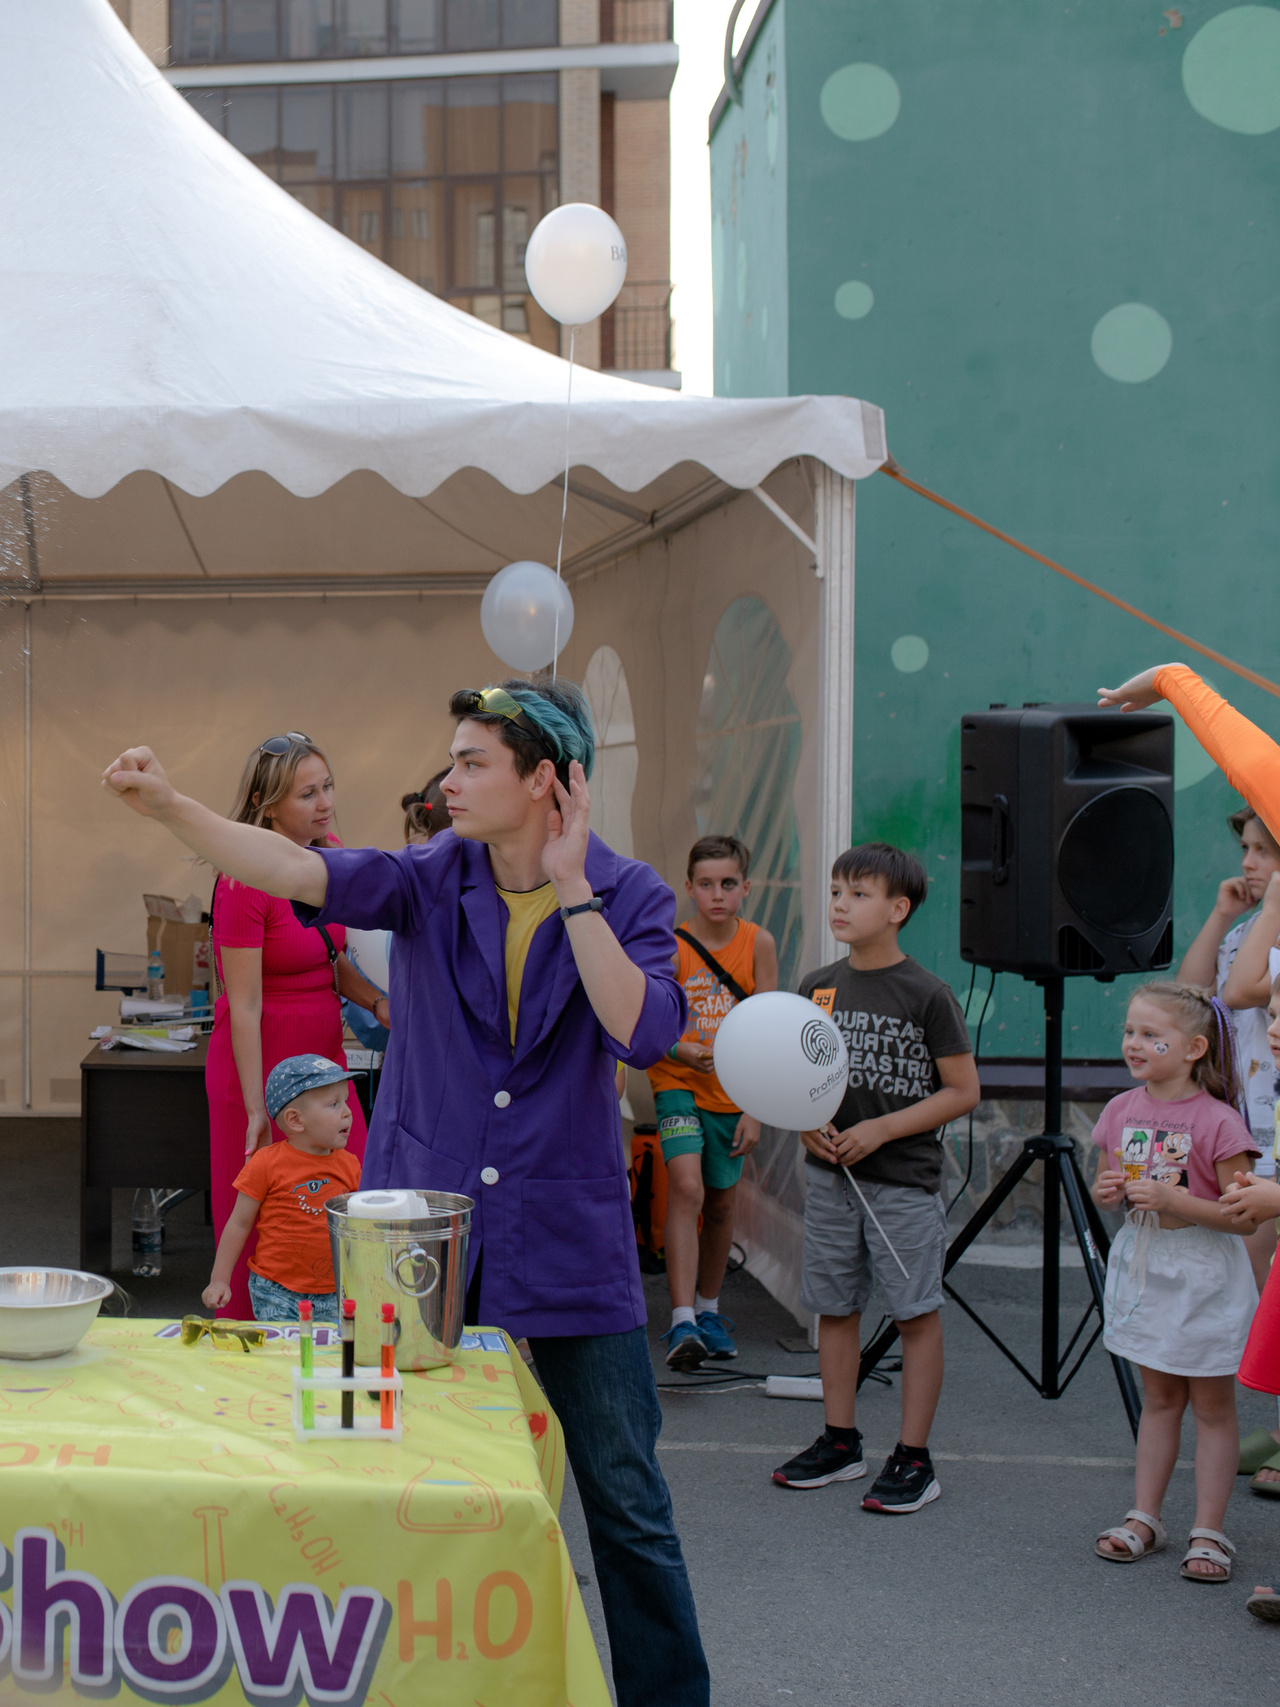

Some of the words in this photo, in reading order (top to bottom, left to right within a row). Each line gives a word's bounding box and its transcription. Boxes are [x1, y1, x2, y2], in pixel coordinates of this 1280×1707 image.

[1125, 1117, 1159, 1127] Where's
[1161, 1120, 1196, 1132] Goofy?
[397, 1570, 534, 1664] H2O
